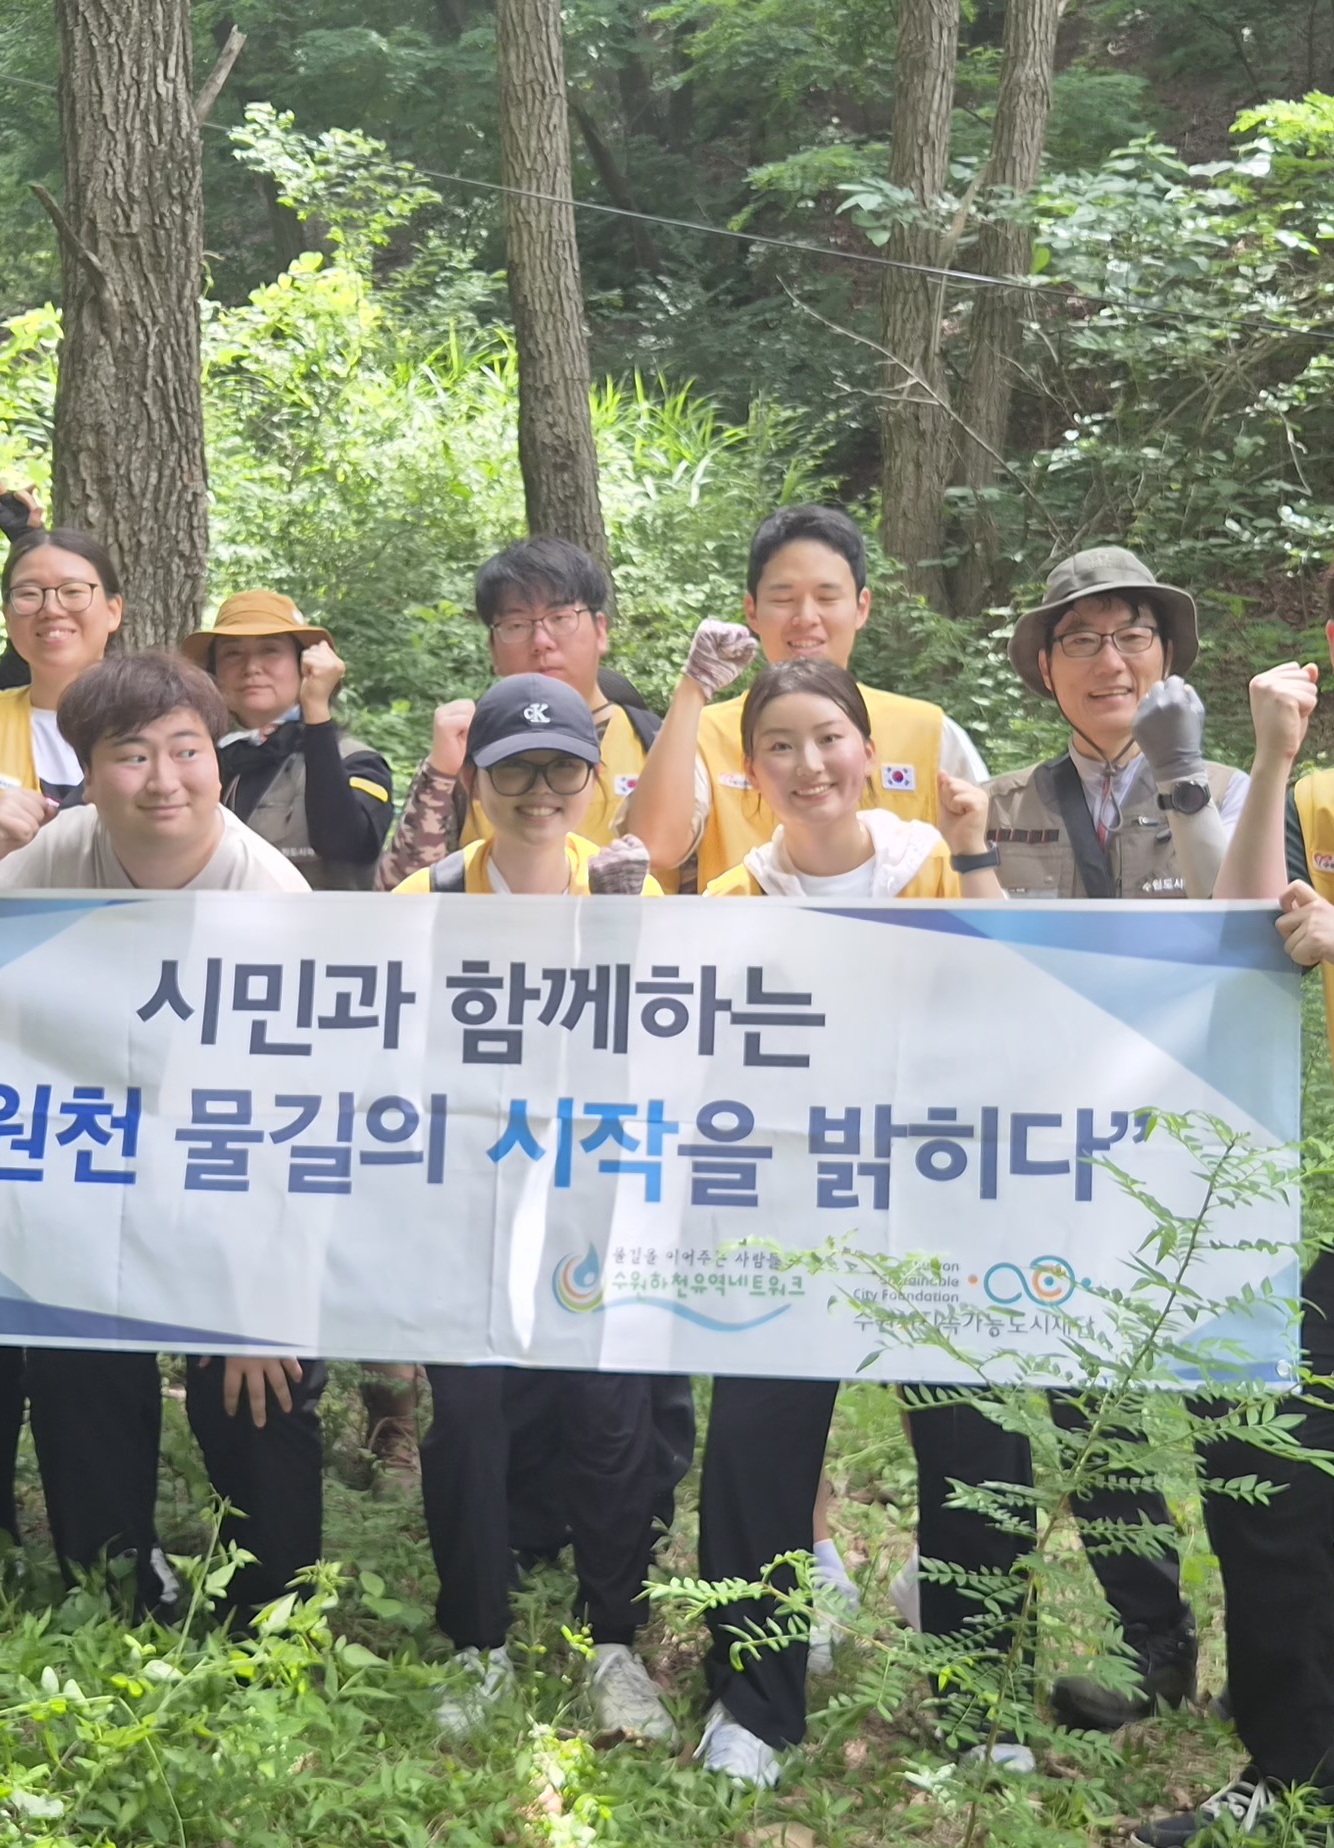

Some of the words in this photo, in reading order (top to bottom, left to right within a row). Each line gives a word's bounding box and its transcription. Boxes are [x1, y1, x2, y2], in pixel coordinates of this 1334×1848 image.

[137, 957, 416, 1056] 시민과
[445, 960, 825, 1068] 함께하는
[175, 1087, 448, 1194] 물길의
[486, 1096, 773, 1207] 시작을
[612, 1270, 805, 1301] 수원하천유역네트워크
[853, 1288, 878, 1301] City
[882, 1289, 959, 1303] Foundation
